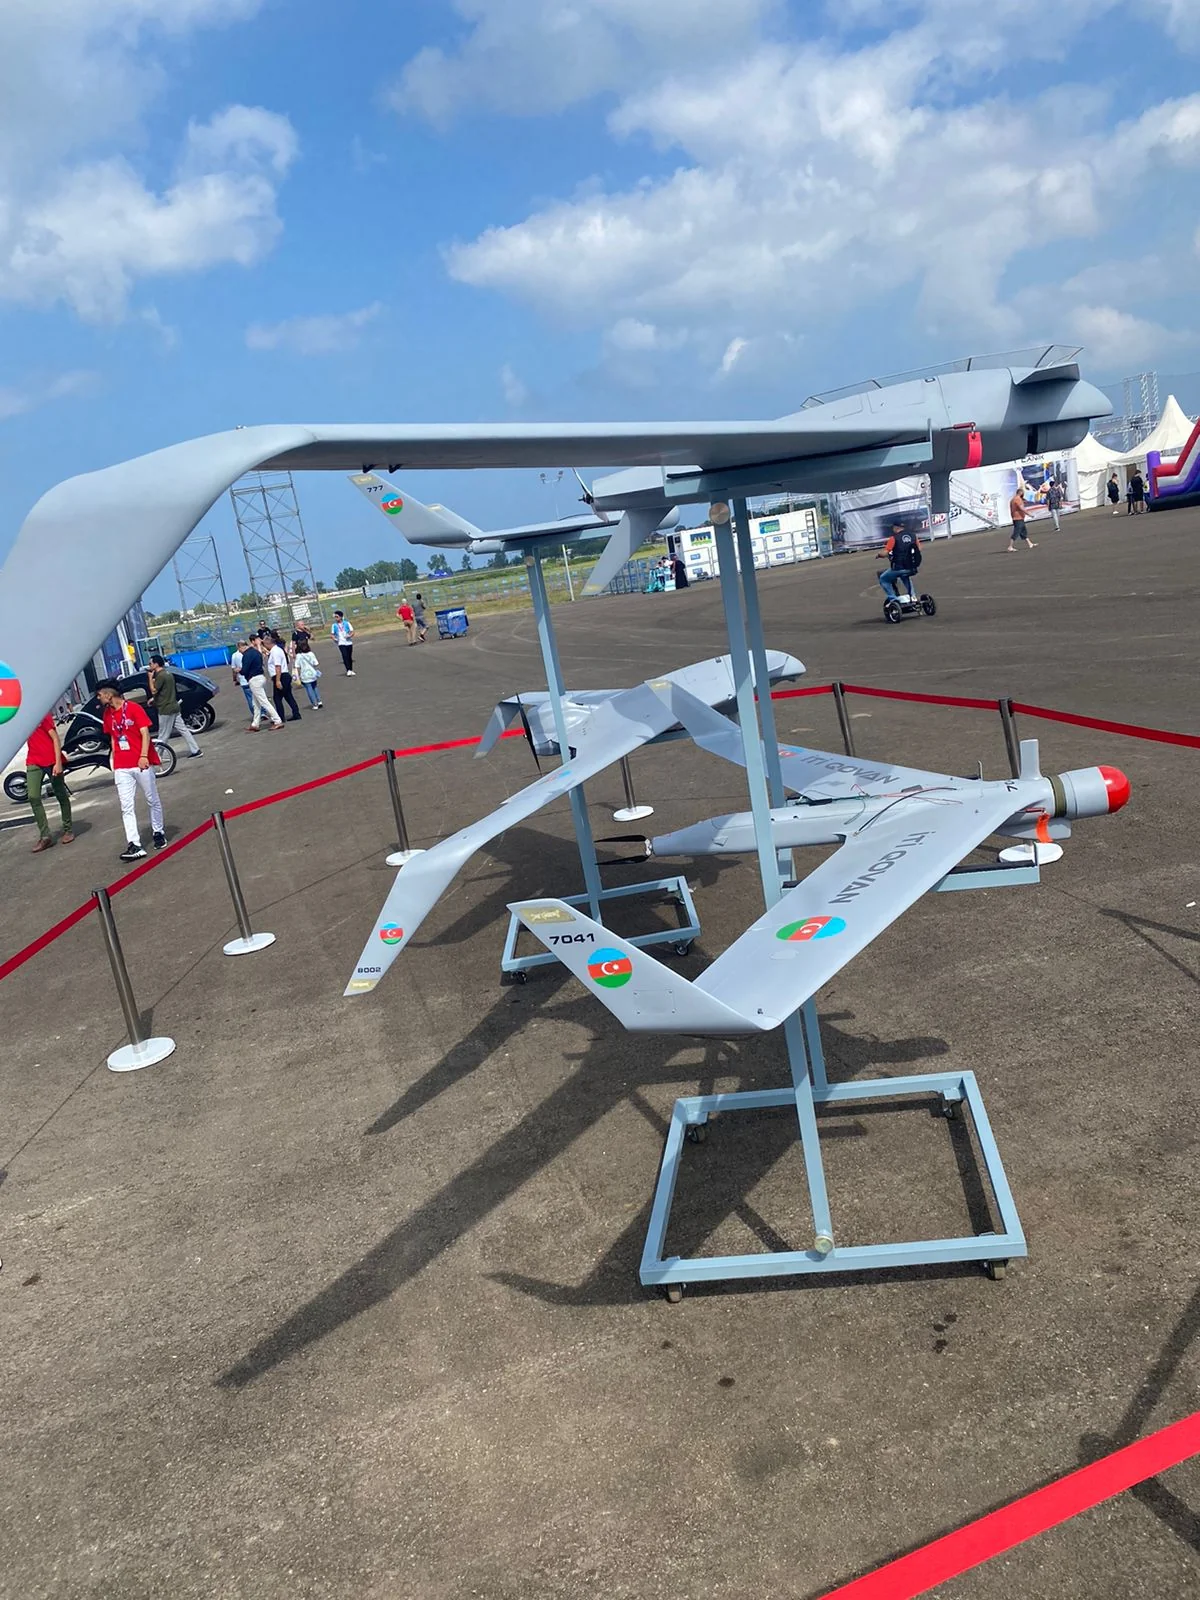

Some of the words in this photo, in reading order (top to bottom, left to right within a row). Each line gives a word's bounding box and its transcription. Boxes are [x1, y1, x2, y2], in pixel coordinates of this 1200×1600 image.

[366, 484, 384, 493] 777
[920, 506, 962, 528] TEKNOEST
[824, 761, 901, 785] QOVAN
[827, 850, 907, 904] QOVAN
[549, 933, 595, 945] 7041
[357, 966, 382, 974] 8002
